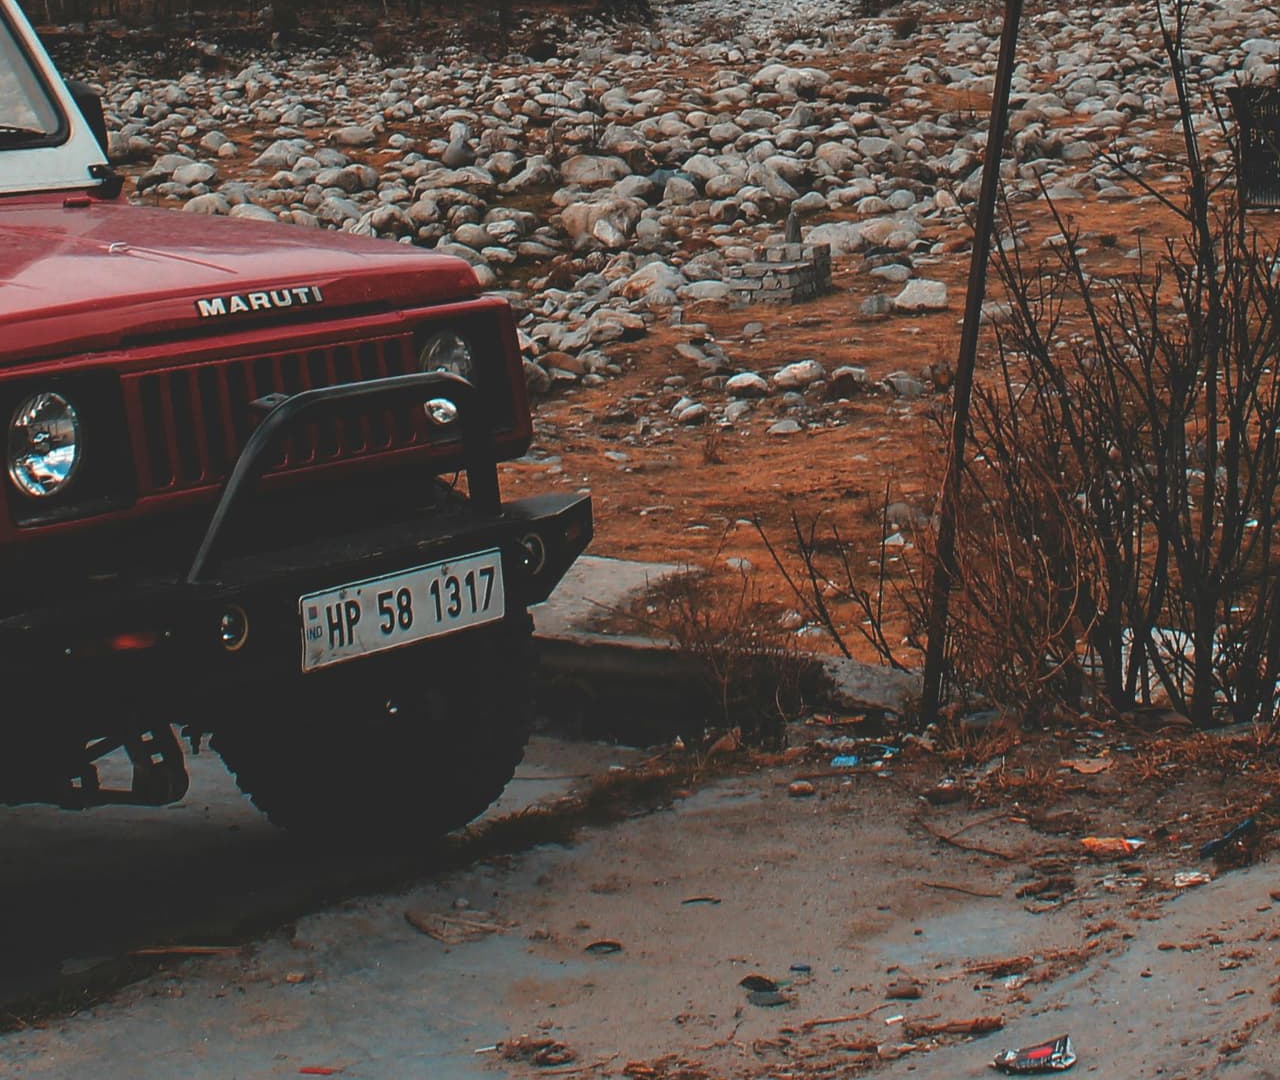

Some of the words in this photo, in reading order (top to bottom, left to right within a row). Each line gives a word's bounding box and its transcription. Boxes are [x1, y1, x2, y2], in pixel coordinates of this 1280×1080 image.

[196, 286, 324, 318] MARUTI
[325, 598, 362, 649] HP
[377, 586, 413, 636] 58
[429, 565, 497, 623] 1317
[306, 626, 323, 641] IND
